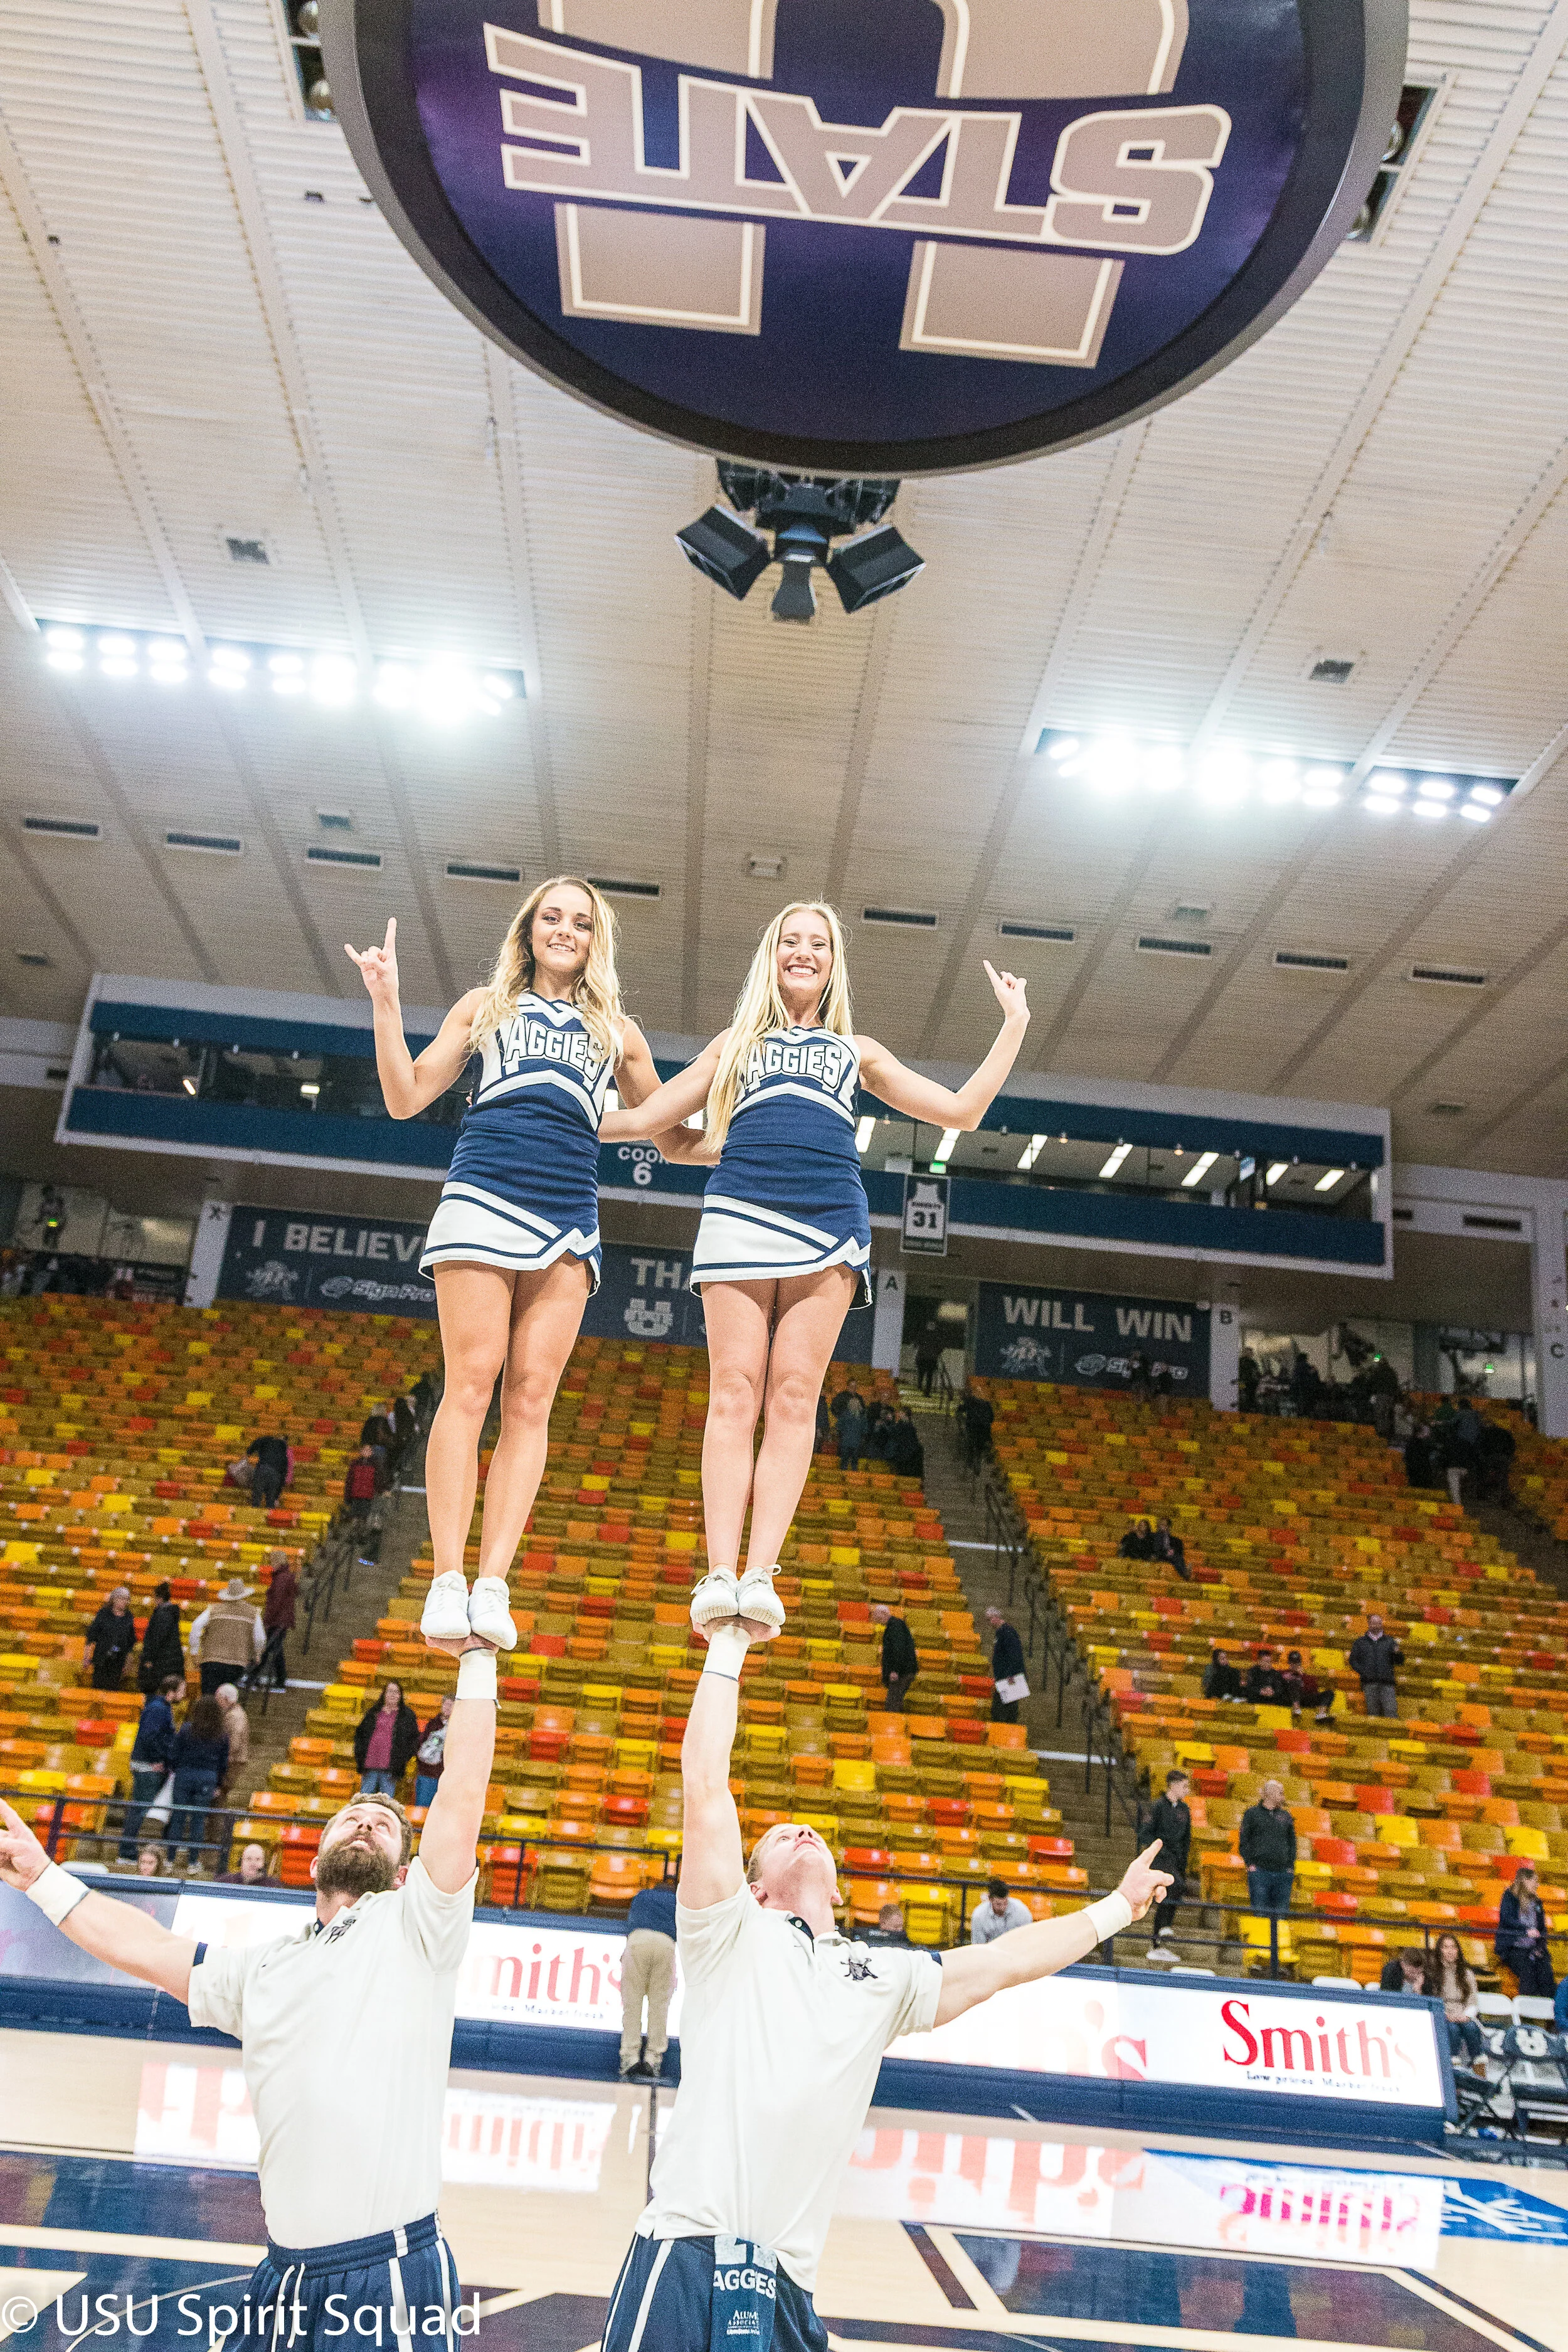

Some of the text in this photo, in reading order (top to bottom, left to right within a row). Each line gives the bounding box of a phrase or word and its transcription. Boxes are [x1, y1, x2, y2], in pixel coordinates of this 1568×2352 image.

[483, 22, 1233, 256] STATE
[745, 1040, 842, 1089] AGGIES
[633, 1161, 652, 1185] 6
[913, 1210, 937, 1229] 31
[253, 1219, 427, 1263] I BELIEV
[886, 1275, 898, 1290] A
[1004, 1295, 1192, 1343] WILL WIN
[1221, 1310, 1232, 1325] B
[1550, 1342, 1565, 1360] C
[1221, 2000, 1417, 2080] Smith's
